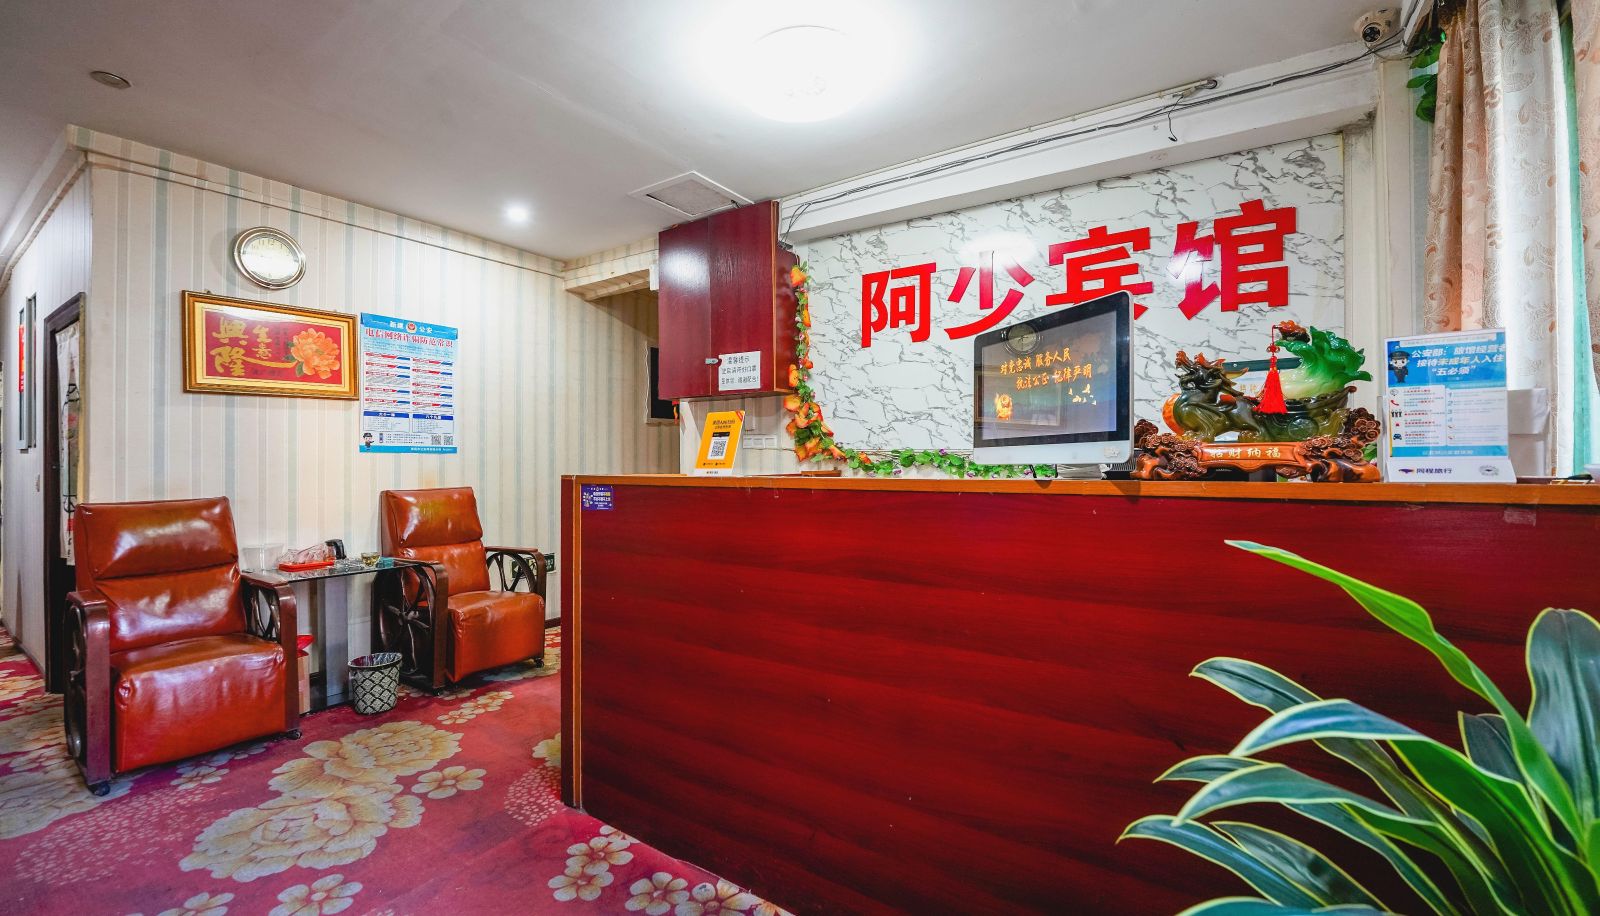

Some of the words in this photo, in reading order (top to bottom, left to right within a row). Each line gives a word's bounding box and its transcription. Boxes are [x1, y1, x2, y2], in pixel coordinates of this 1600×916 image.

[861, 199, 1297, 348] 阿少宾馆
[365, 328, 453, 348] 电信网络诈骗防范常识
[419, 326, 433, 334] 公安
[252, 324, 273, 360] 生意
[1000, 356, 1033, 376] 对党忠诚
[1035, 347, 1071, 368] 服务人民
[1416, 354, 1505, 368] 接待未成年人入住
[1015, 372, 1050, 391] 执法公正
[1053, 363, 1093, 384] 纪律严明
[1210, 447, 1281, 459] 招财纳福
[1416, 467, 1452, 475] 同程旅行
